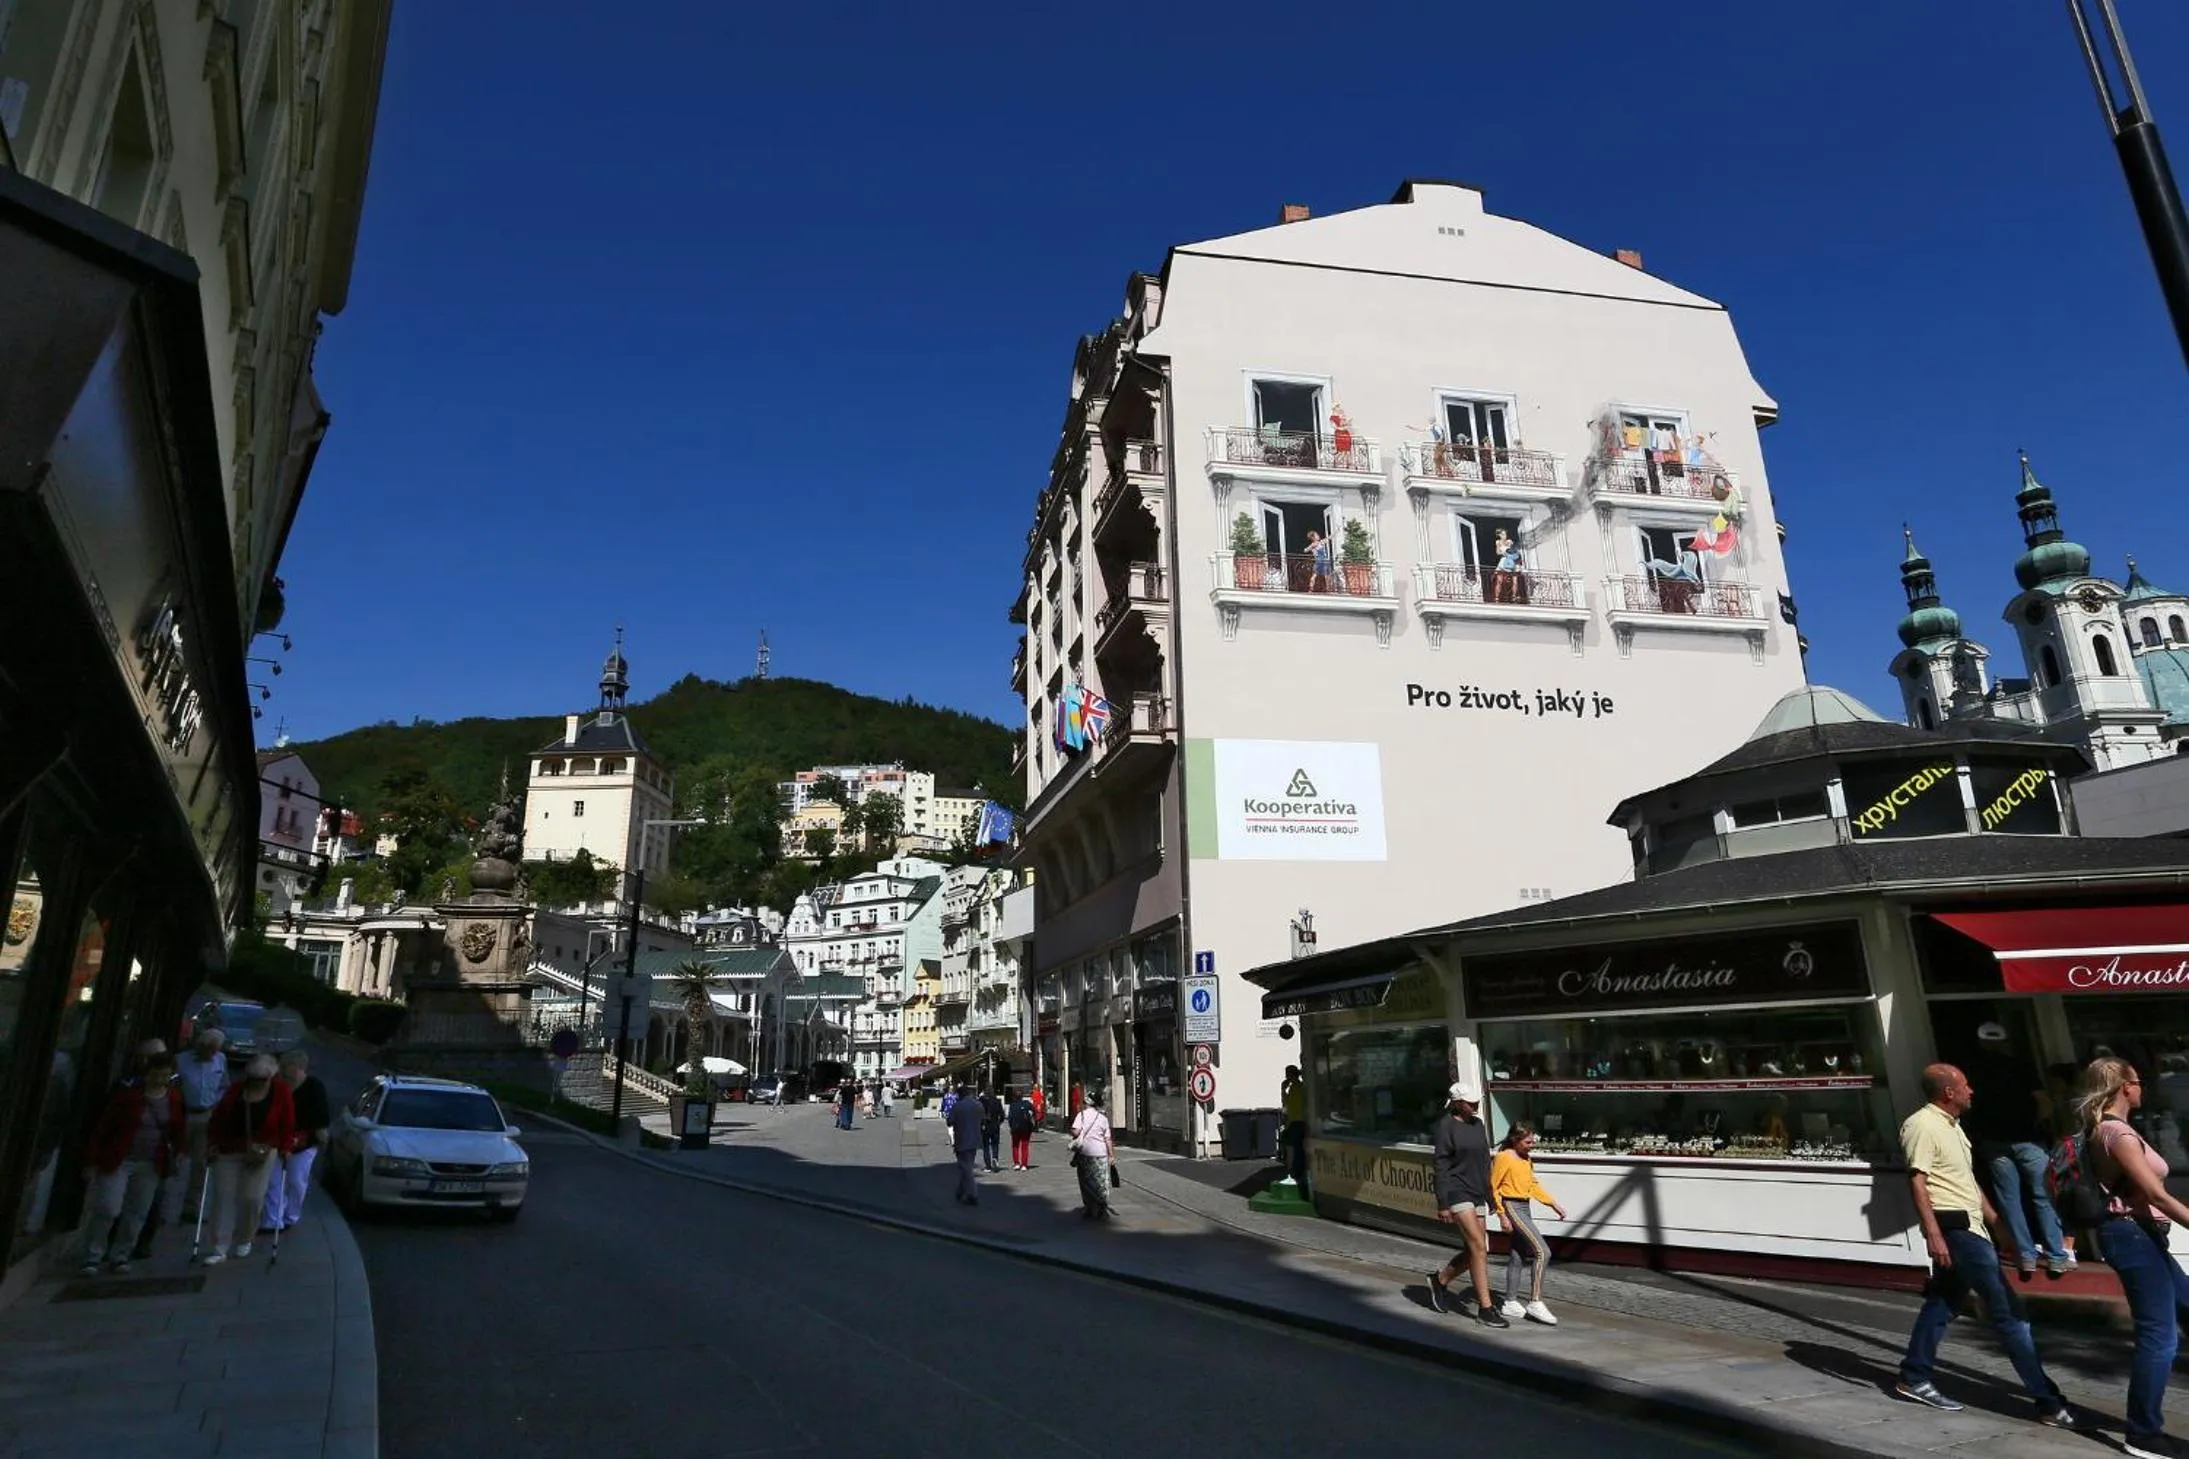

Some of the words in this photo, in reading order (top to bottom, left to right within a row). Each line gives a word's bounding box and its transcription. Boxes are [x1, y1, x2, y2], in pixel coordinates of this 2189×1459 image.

[1406, 684, 1452, 707] Pro
[1459, 685, 1530, 715] život,
[1535, 688, 1586, 718] jaký
[1591, 691, 1614, 718] je
[1244, 799, 1357, 818] Kooperativa
[1246, 825, 1278, 834] VIENNA
[1281, 825, 1328, 835] INSURANCE
[1331, 826, 1360, 835] GROUP
[1557, 956, 1738, 997] Anastasia
[2068, 956, 2189, 987] Anast
[1315, 1147, 1336, 1174] The
[1339, 1151, 1361, 1181] Art
[1363, 1156, 1376, 1183] of
[1379, 1156, 1436, 1193] Chocola
